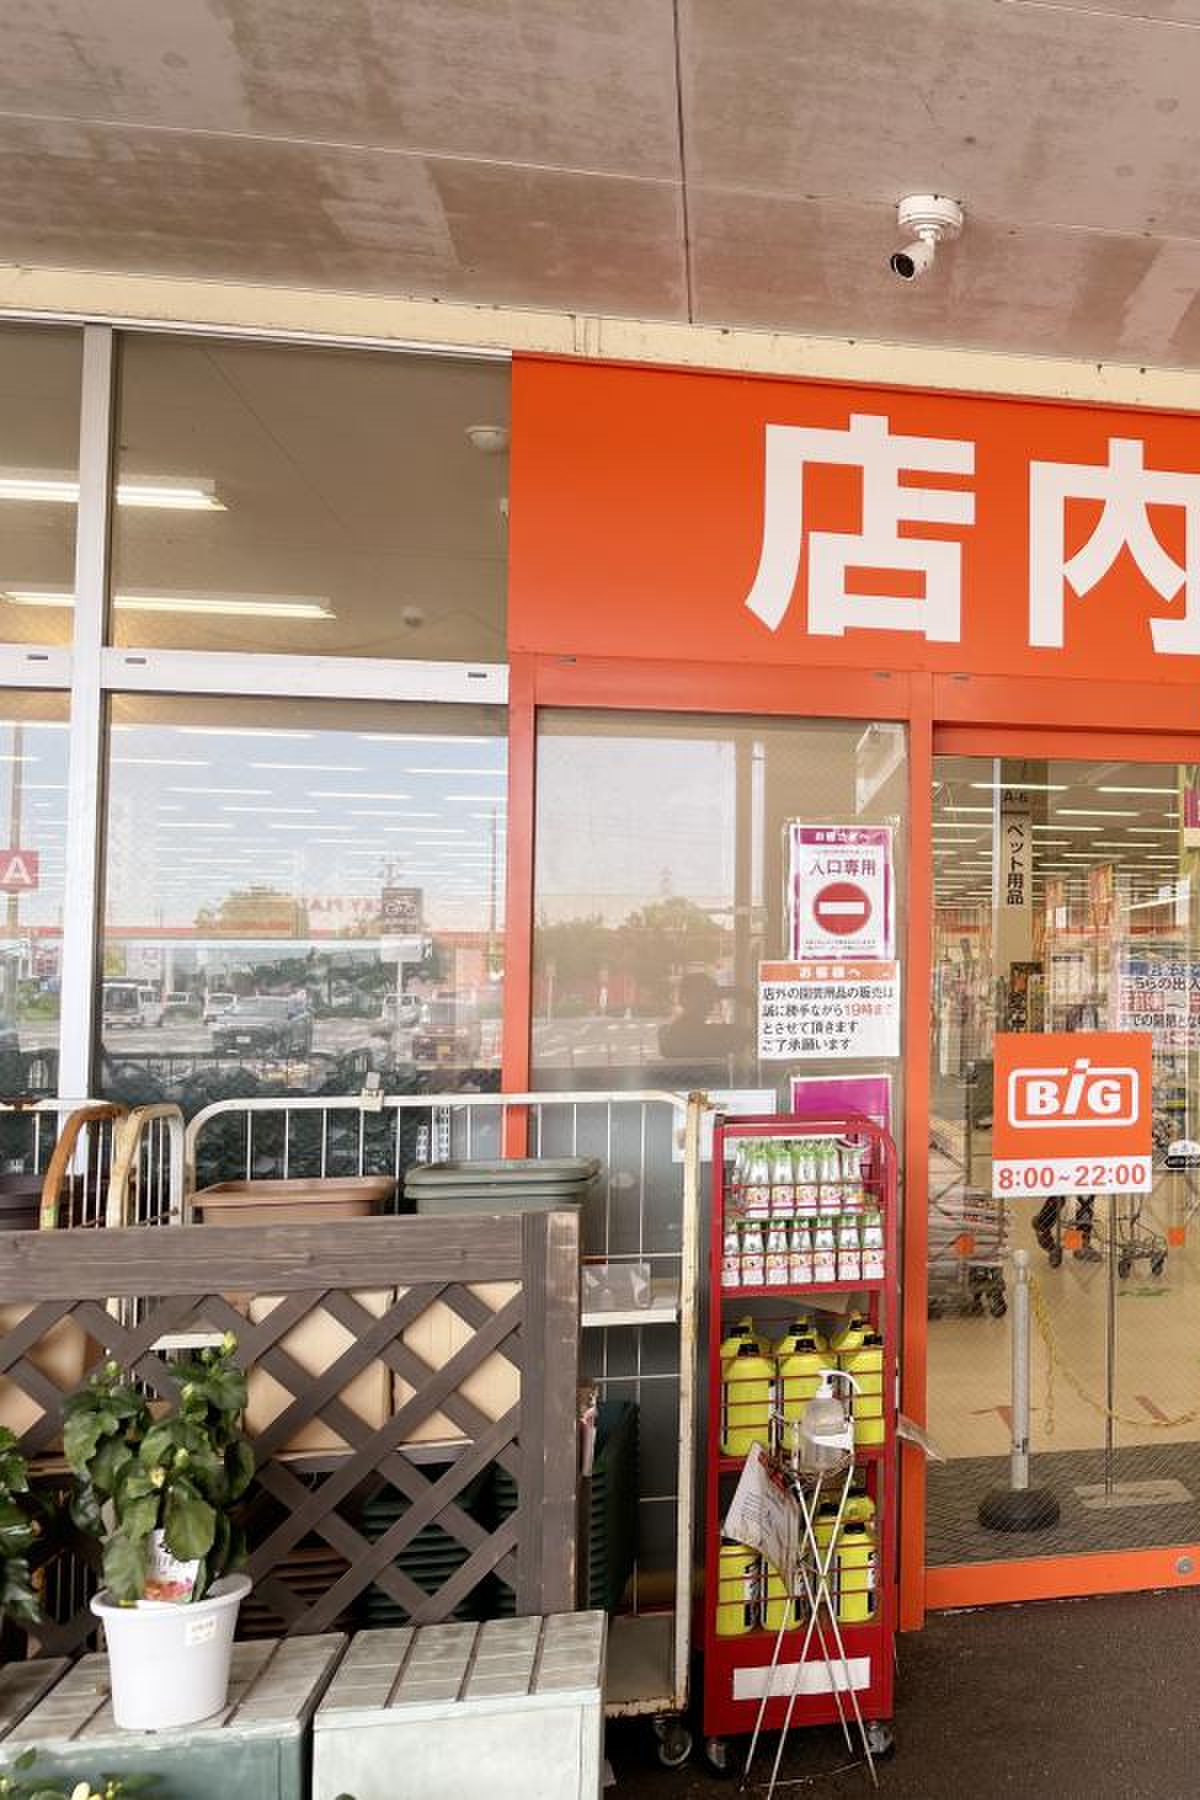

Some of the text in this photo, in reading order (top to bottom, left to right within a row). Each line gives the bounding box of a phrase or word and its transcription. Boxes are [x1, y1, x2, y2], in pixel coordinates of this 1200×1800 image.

[1, 856, 32, 884] A
[809, 859, 876, 877] 入口専用
[763, 1021, 858, 1035] とさせて頂きます
